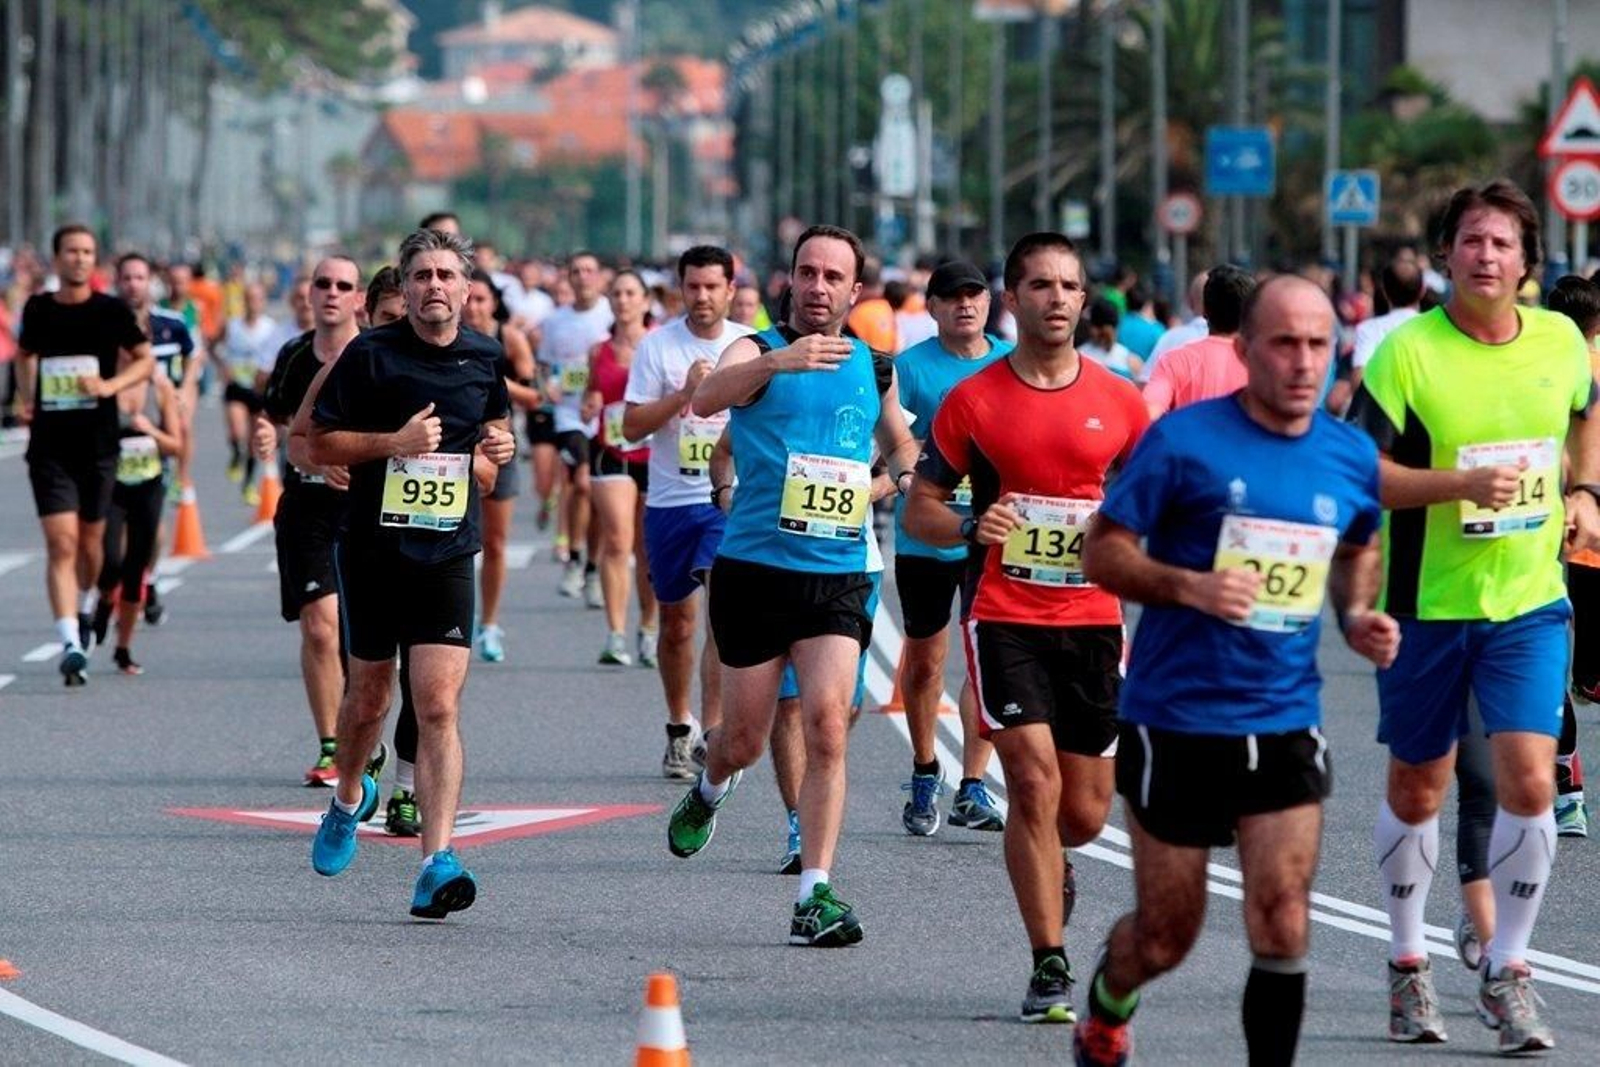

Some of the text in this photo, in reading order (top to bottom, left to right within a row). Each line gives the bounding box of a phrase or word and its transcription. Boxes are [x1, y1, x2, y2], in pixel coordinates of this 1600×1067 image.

[402, 479, 455, 507] 935
[801, 484, 854, 515] 158
[1024, 528, 1086, 560] 134
